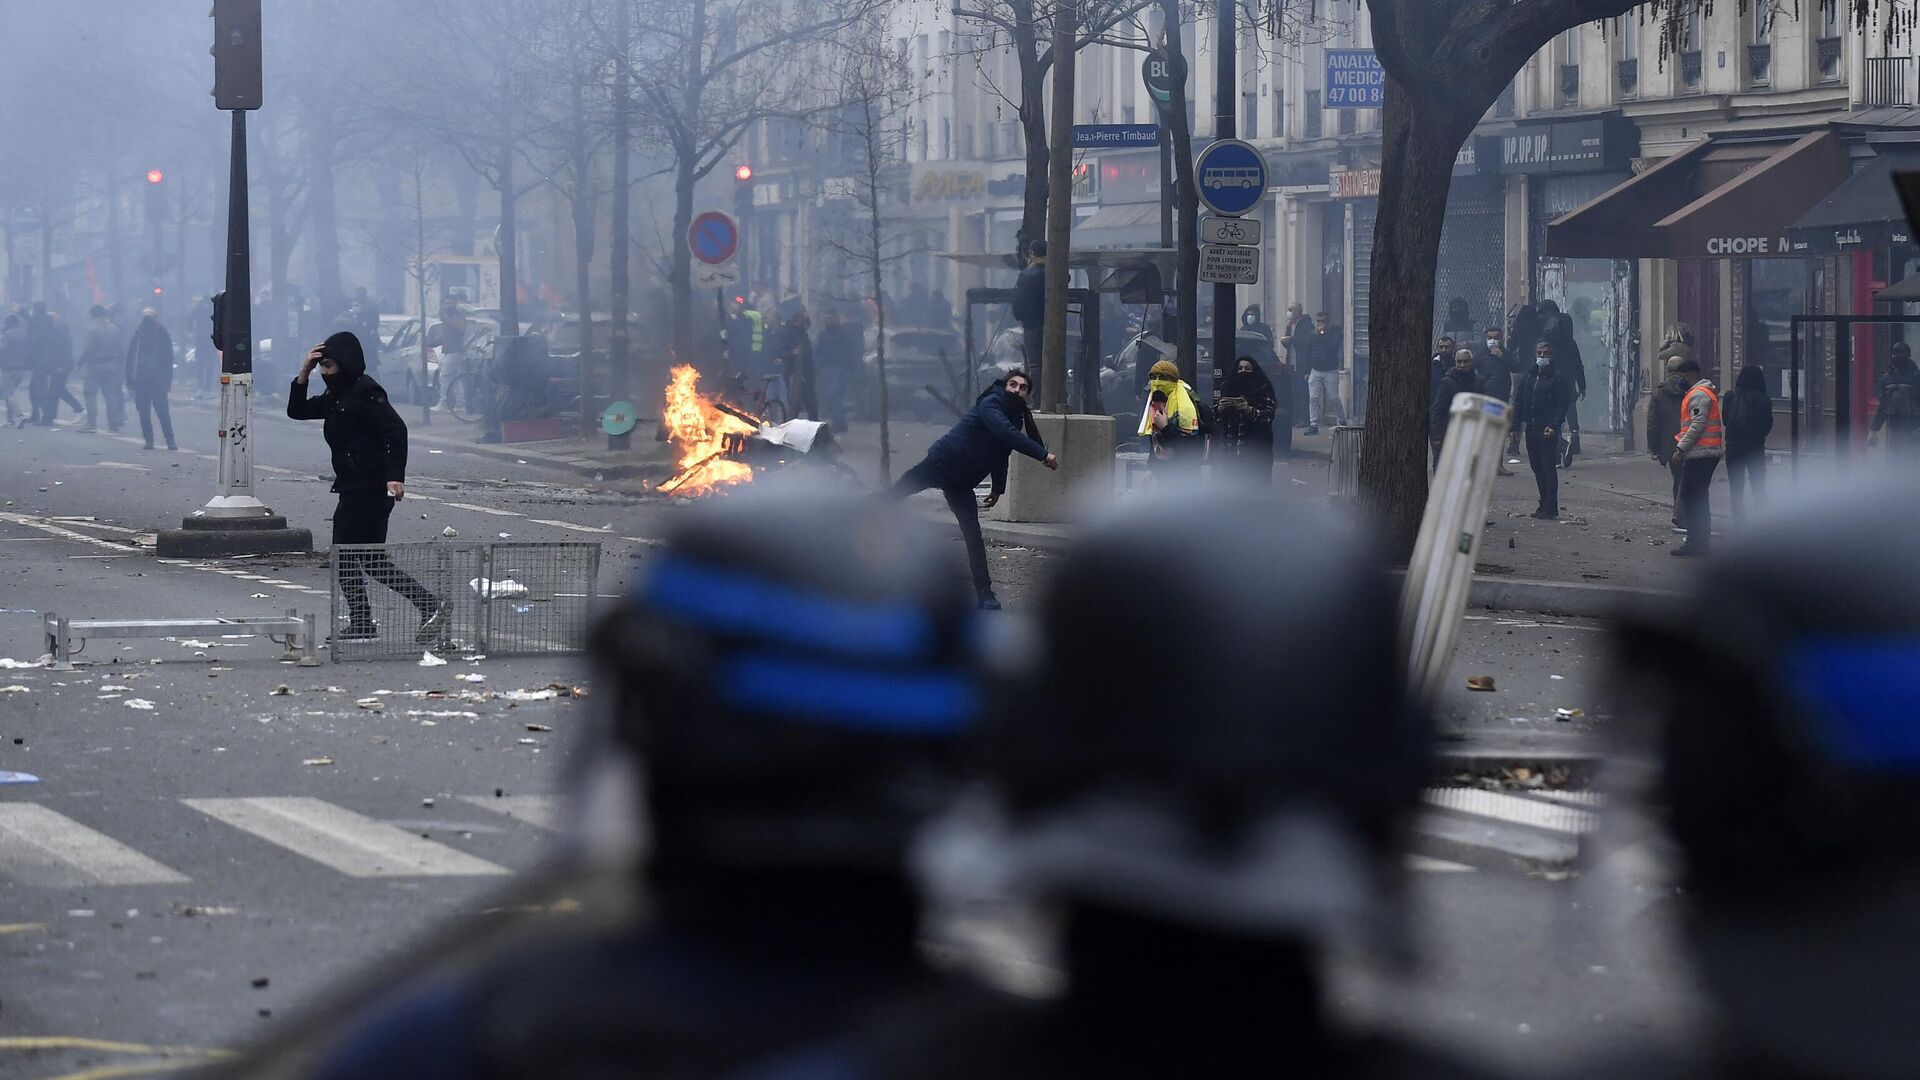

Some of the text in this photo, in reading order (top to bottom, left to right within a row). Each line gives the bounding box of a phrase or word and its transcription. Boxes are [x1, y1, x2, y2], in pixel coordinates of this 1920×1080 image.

[1328, 88, 1345, 102] 47
[1349, 88, 1366, 102] 00
[1077, 130, 1156, 142] Jean-Pierre Timbaud
[1706, 237, 1768, 254] CHOPE
